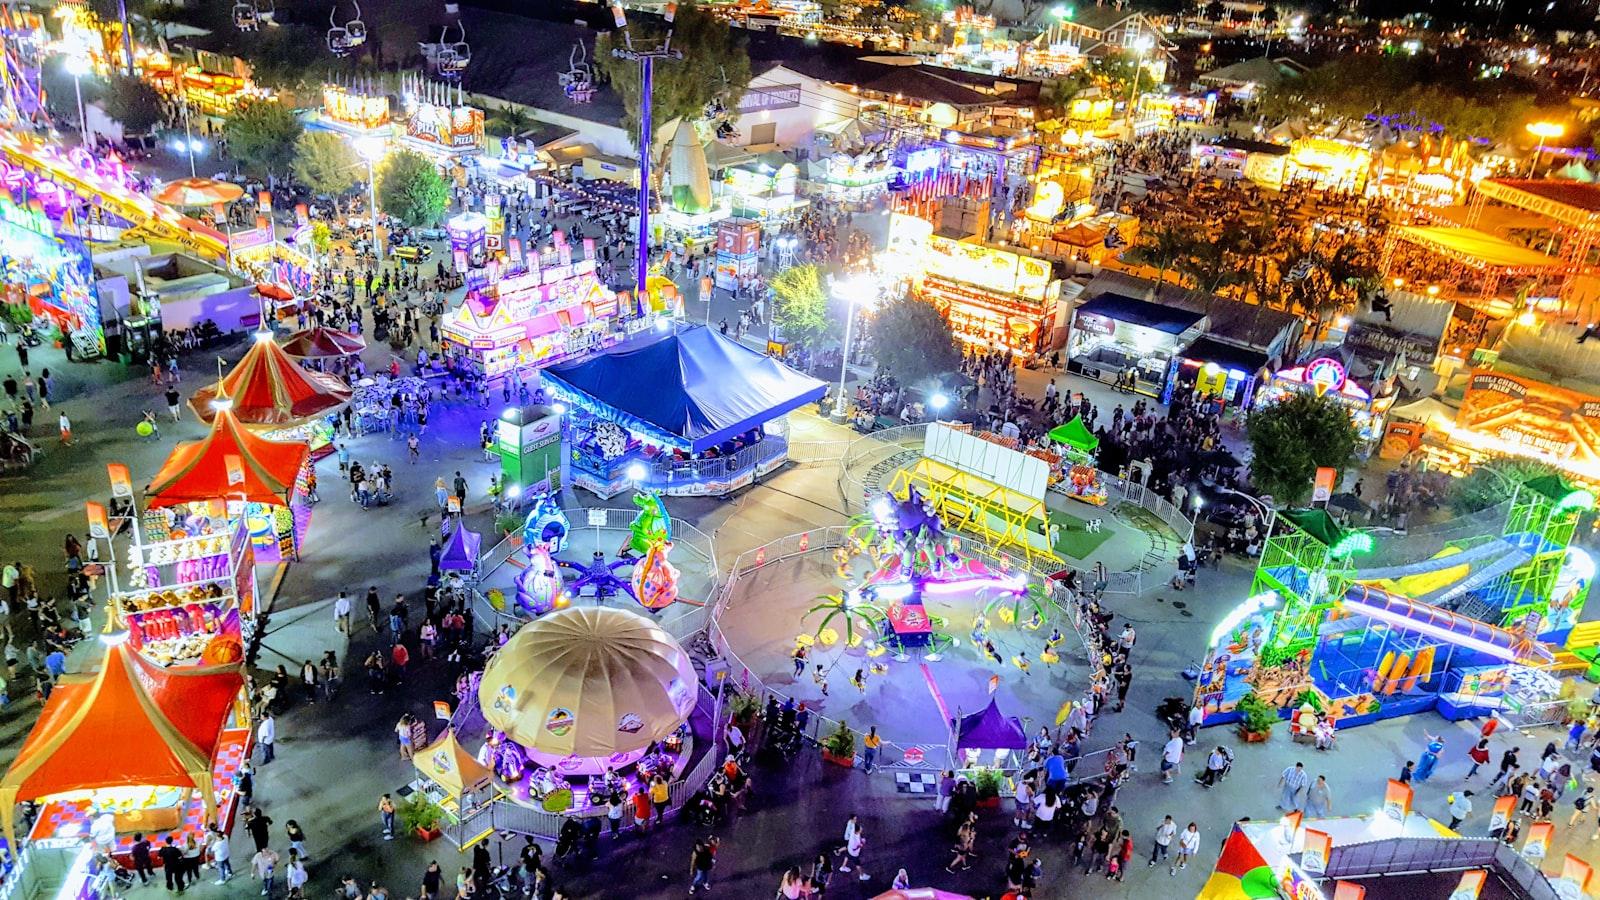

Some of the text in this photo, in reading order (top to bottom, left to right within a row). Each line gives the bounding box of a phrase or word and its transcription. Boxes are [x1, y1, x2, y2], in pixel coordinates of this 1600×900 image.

[761, 92, 769, 106] OF
[770, 89, 799, 104] PRODUCTS
[416, 121, 441, 140] PIZZA
[454, 134, 474, 145] PIZZA
[1496, 187, 1547, 211] HERITAGE
[103, 200, 123, 214] IT'S
[130, 213, 147, 224] FUN
[153, 225, 171, 235] FUN
[1348, 335, 1392, 353] CHICKEN
[1368, 333, 1415, 350] HAWAIIAN
[1474, 375, 1528, 395] CHILI CHEESE
[1488, 384, 1511, 394] FRIES
[1500, 427, 1523, 441] GOOD
[524, 442, 539, 454] GUEST
[539, 434, 560, 449] SERVICES
